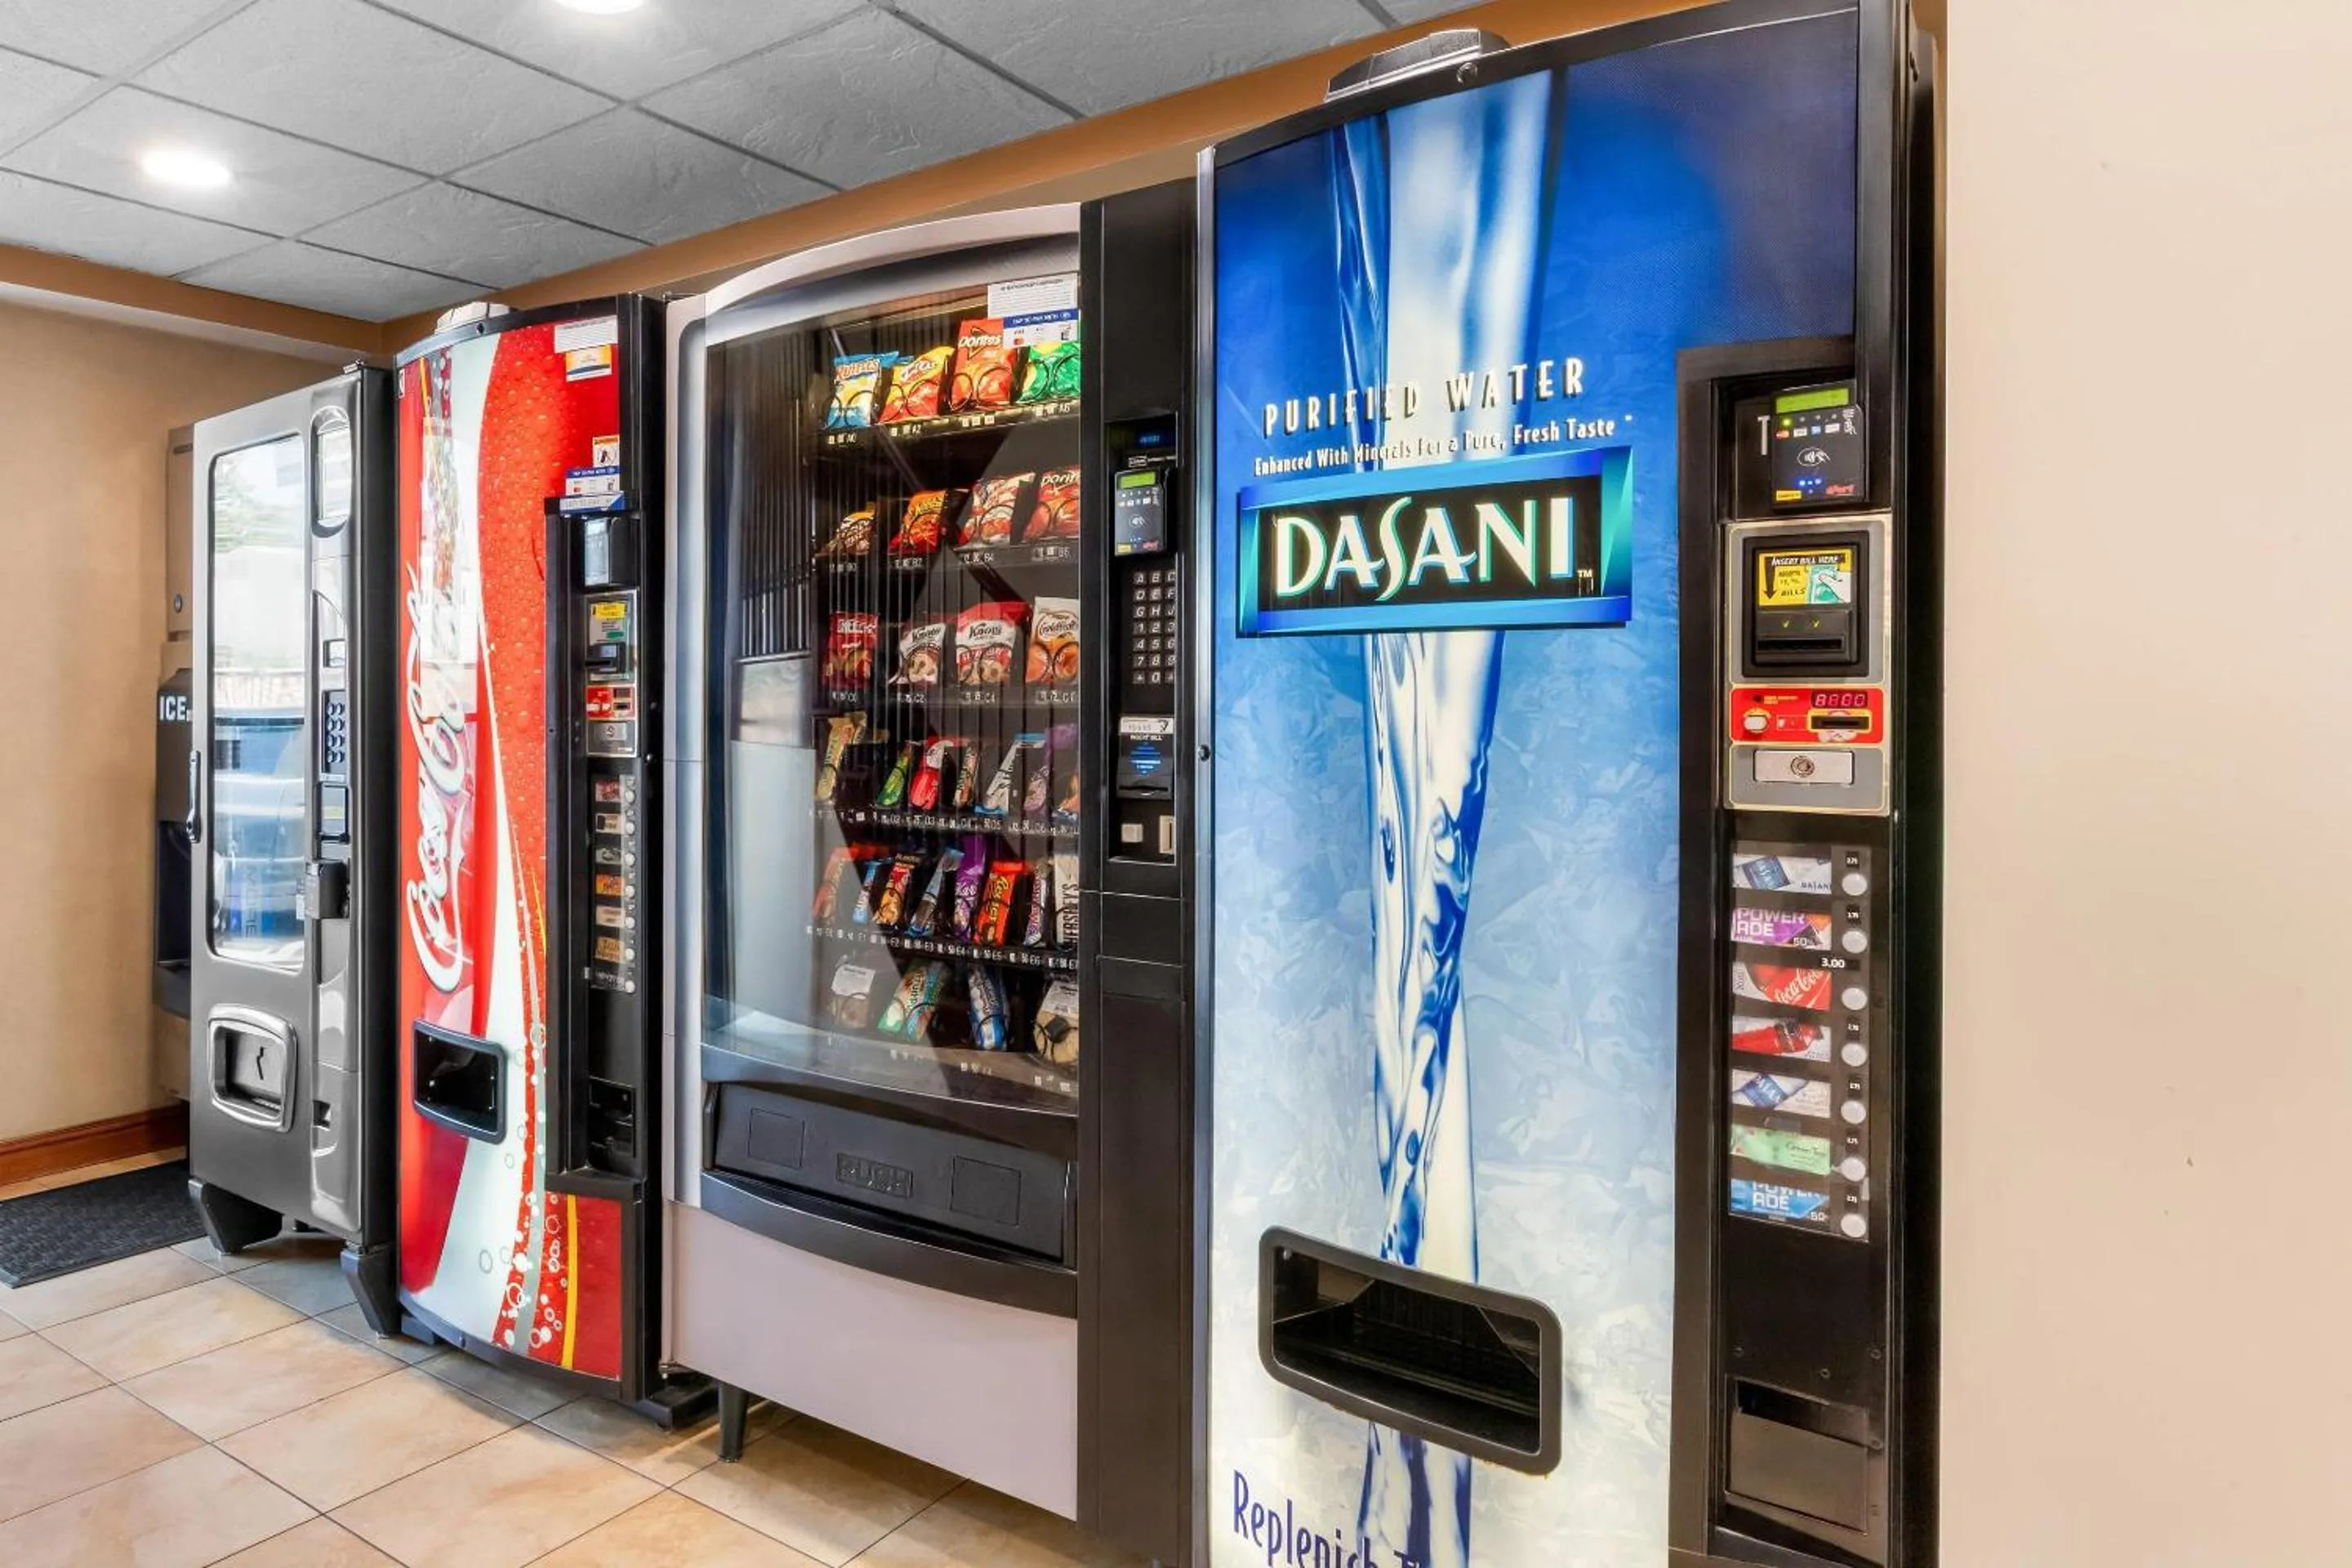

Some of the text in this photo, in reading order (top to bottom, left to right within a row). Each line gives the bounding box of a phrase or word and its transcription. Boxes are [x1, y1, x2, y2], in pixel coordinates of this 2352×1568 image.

[958, 335, 1002, 348] Doritos
[1264, 357, 1584, 439] PURIFIED WATER
[1254, 457, 1312, 477] Enhanced
[1316, 449, 1348, 469] With
[1352, 442, 1412, 463] Minerals
[1448, 438, 1458, 453] a
[1513, 421, 1560, 445] Fresh
[1566, 416, 1615, 439] Taste
[1274, 497, 1575, 601] DASANI
[159, 695, 187, 721] ICE
[406, 560, 468, 994] Coca-Cola
[1821, 957, 1846, 969] 3.00
